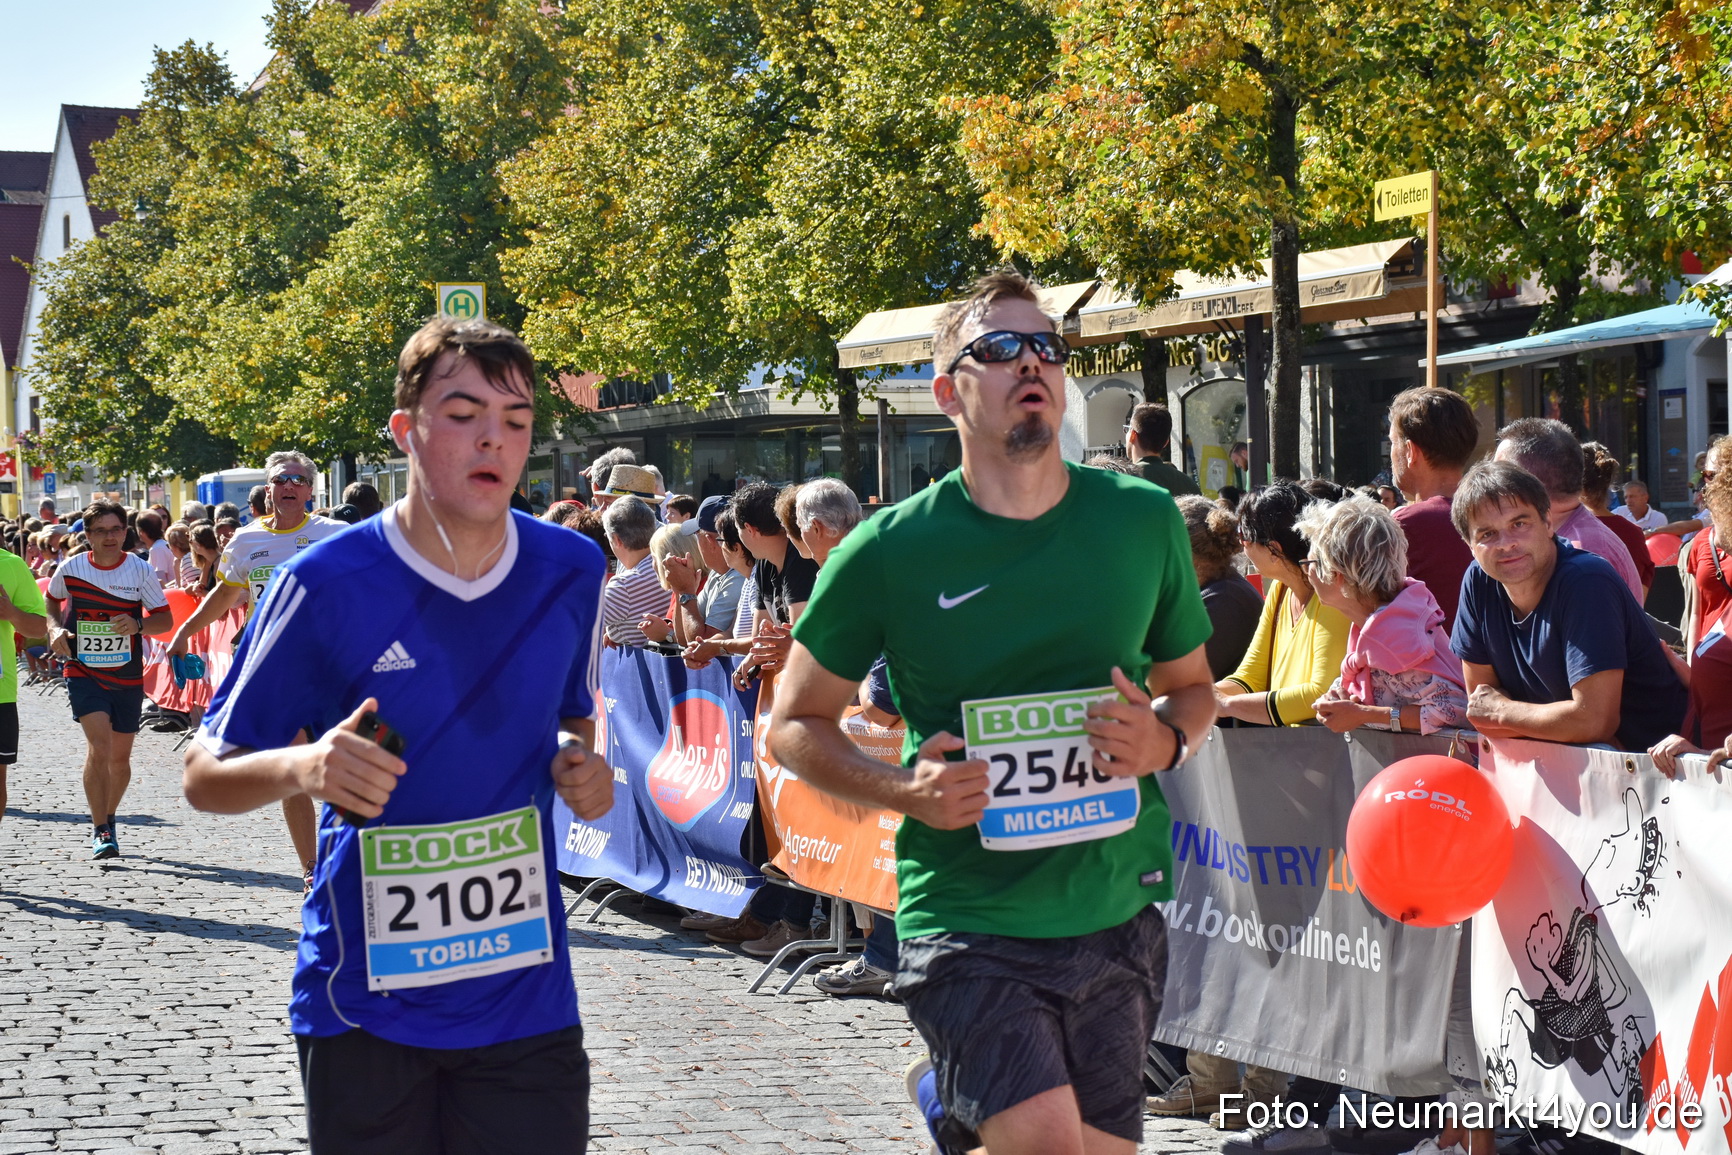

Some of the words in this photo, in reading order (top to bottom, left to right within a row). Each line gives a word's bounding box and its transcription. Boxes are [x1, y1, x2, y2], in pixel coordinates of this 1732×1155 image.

[1385, 187, 1428, 207] Toiletten
[453, 297, 470, 317] H
[46, 475, 53, 491] P
[253, 569, 273, 580] BO
[82, 624, 112, 633] BOC
[83, 637, 124, 652] 2327
[84, 655, 124, 663] GERHARD
[372, 658, 416, 672] adidas
[981, 699, 1092, 736] BOC
[741, 719, 754, 737] STO
[653, 723, 728, 800] Hervis
[1003, 800, 1115, 833] MICHAEL
[1429, 803, 1470, 822] energie
[379, 821, 523, 866] BOCK
[784, 825, 843, 865] Agentur
[684, 855, 706, 890] GET
[386, 868, 526, 933] 2102
[410, 932, 512, 968] TOBIAS
